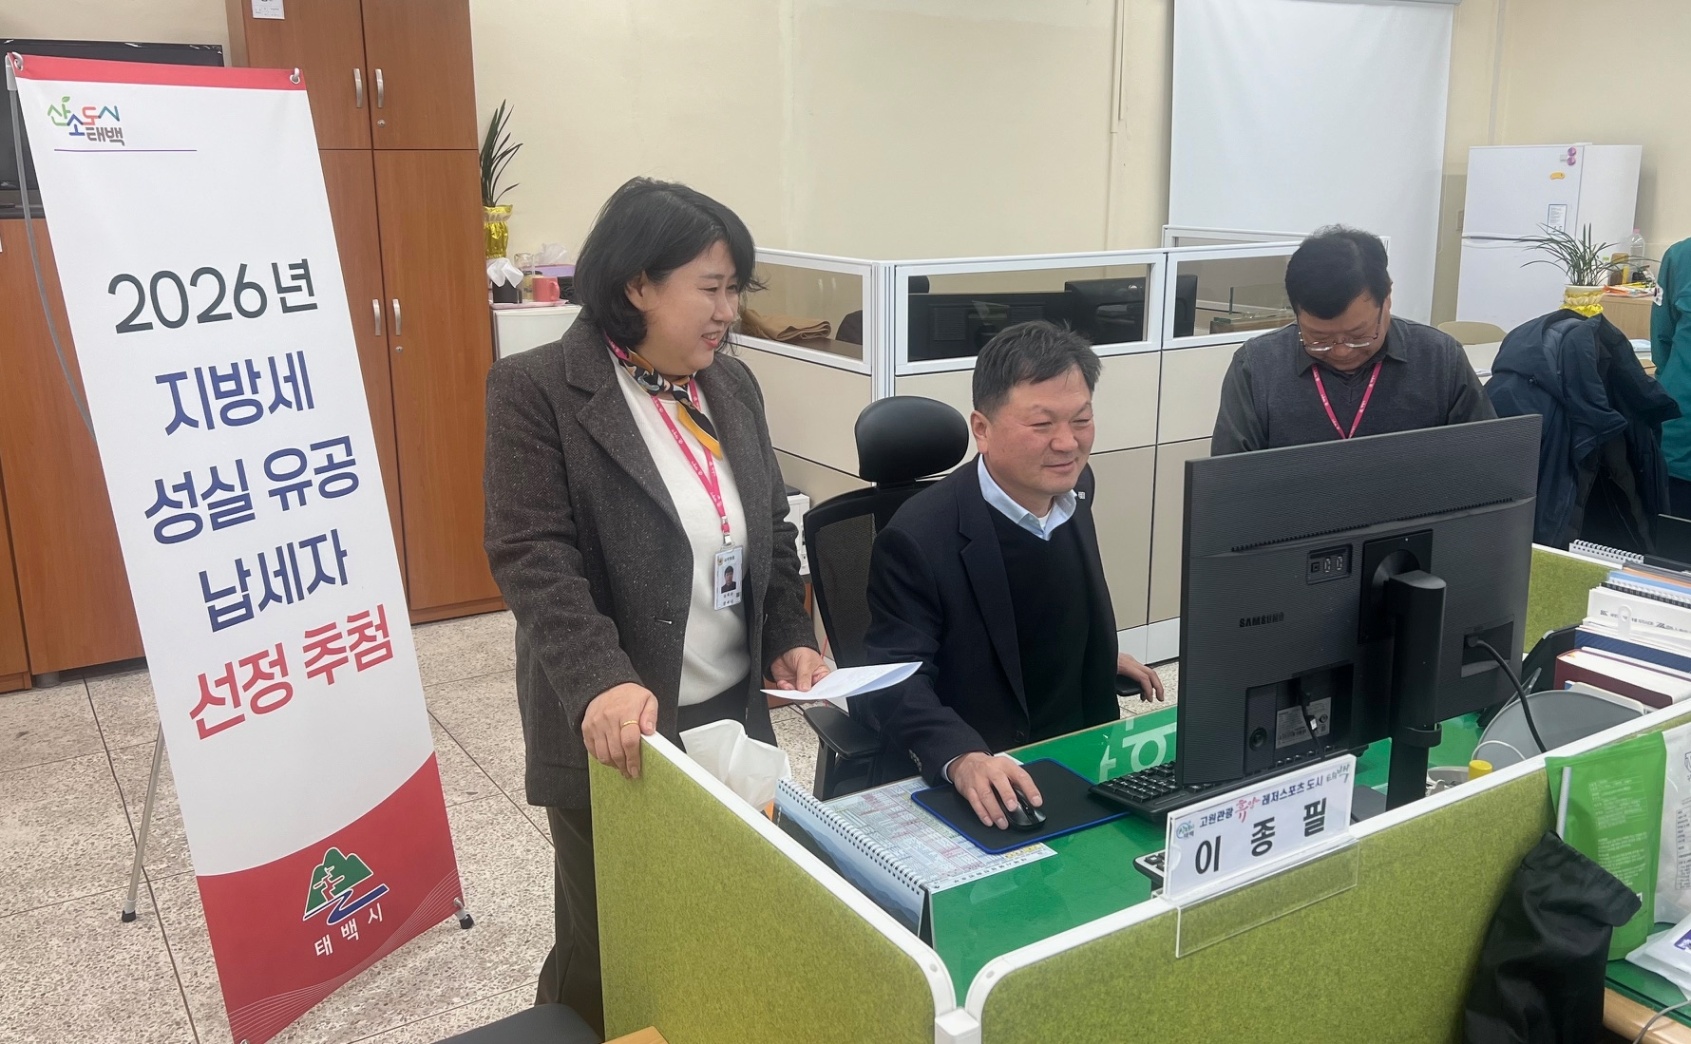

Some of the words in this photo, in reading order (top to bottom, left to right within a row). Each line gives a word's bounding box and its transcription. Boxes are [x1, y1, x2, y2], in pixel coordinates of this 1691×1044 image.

[85, 127, 125, 146] 태백
[155, 350, 315, 436] 지방세
[144, 458, 256, 545] 성실
[263, 435, 360, 512] 유공
[198, 528, 349, 633] 납세자
[1240, 612, 1284, 627] SAMSUNG
[189, 642, 294, 740] 선정
[302, 603, 394, 686] 추첨
[1200, 807, 1233, 827] 고원관광
[1261, 782, 1305, 806] 레저스포츠
[1306, 775, 1324, 791] 도시
